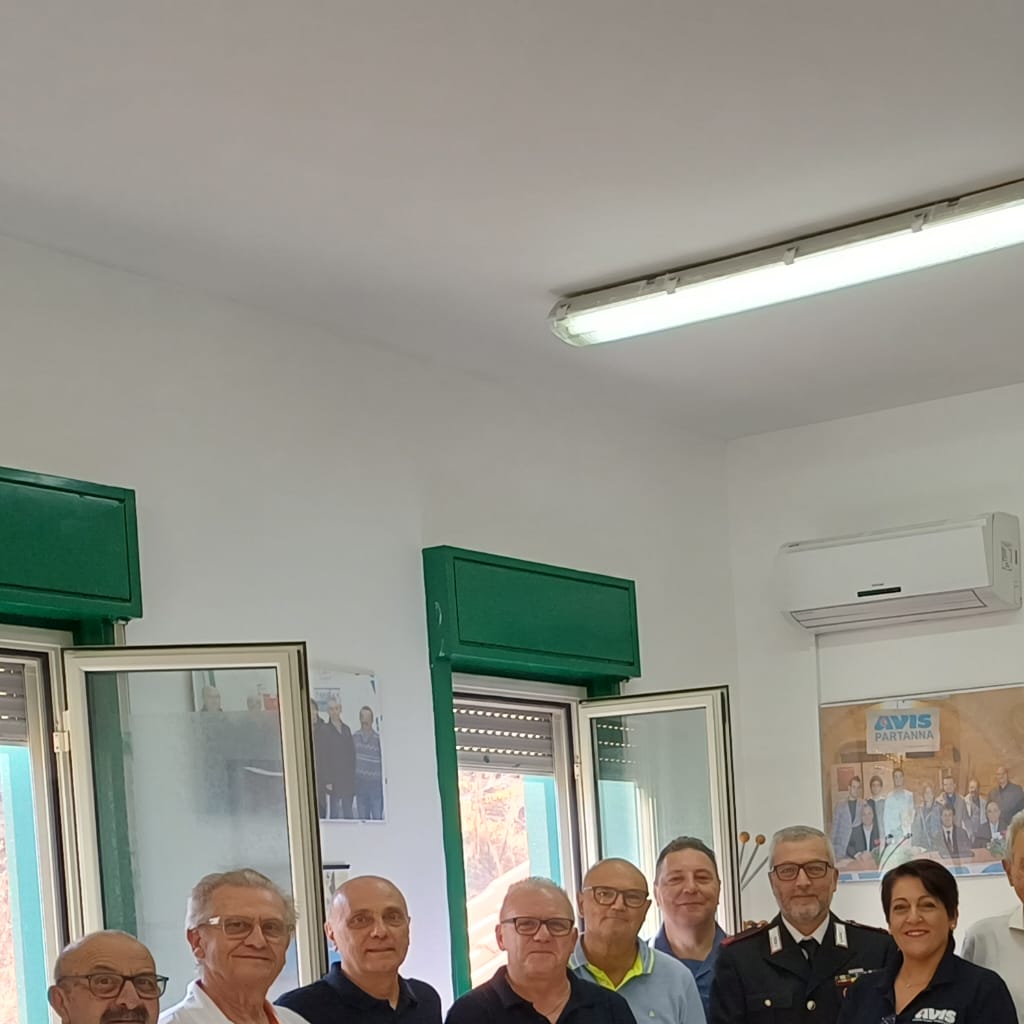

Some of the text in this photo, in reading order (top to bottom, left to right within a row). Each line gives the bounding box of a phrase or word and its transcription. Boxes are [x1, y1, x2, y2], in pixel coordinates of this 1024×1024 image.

[874, 713, 932, 731] AVIS
[875, 730, 935, 742] PARTANNA
[915, 1007, 957, 1024] AVIS
